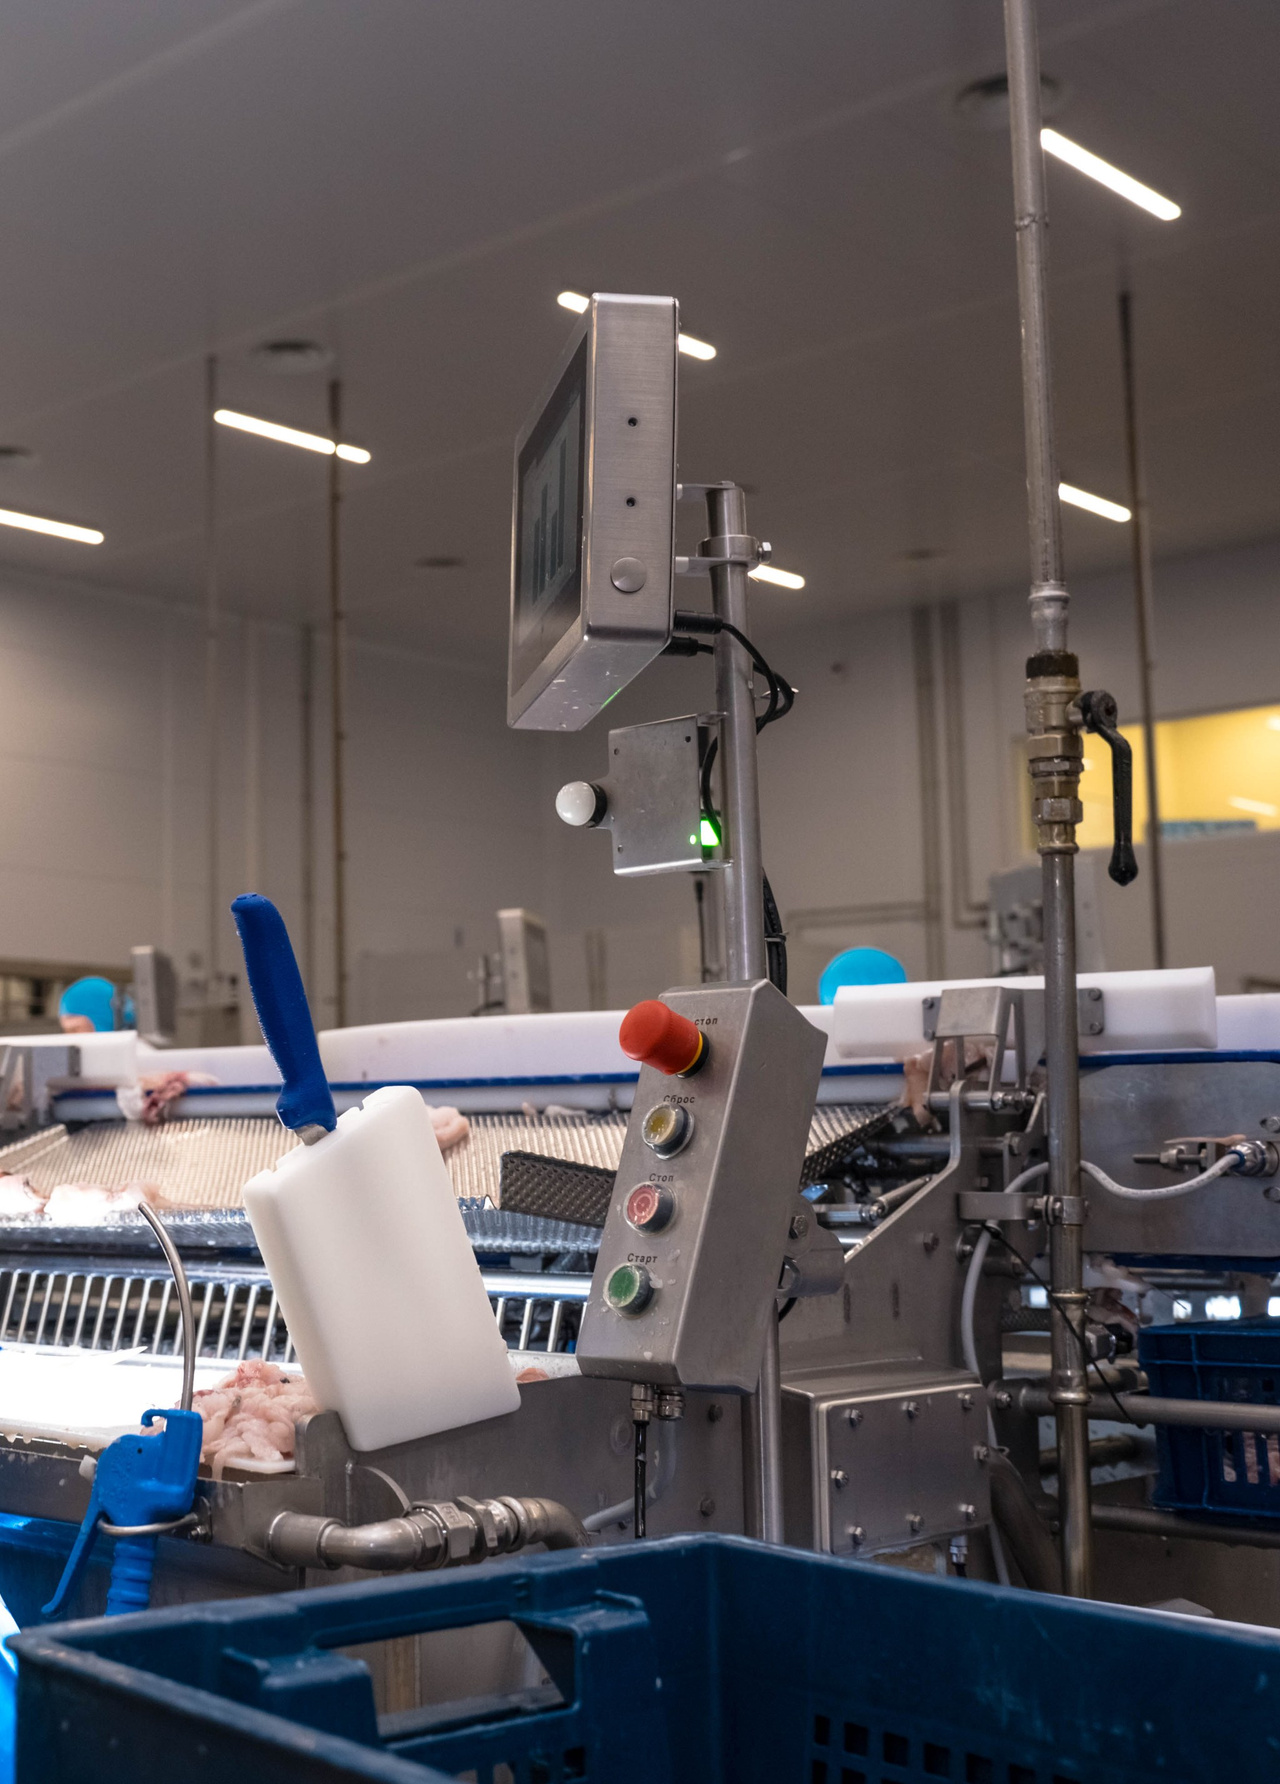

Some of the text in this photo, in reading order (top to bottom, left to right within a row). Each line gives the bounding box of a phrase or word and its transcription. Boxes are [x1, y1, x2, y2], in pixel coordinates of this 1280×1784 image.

[694, 1017, 718, 1026] стоп
[663, 1094, 695, 1105] Сброс
[649, 1173, 674, 1182] Стоп
[627, 1252, 658, 1265] Старт
